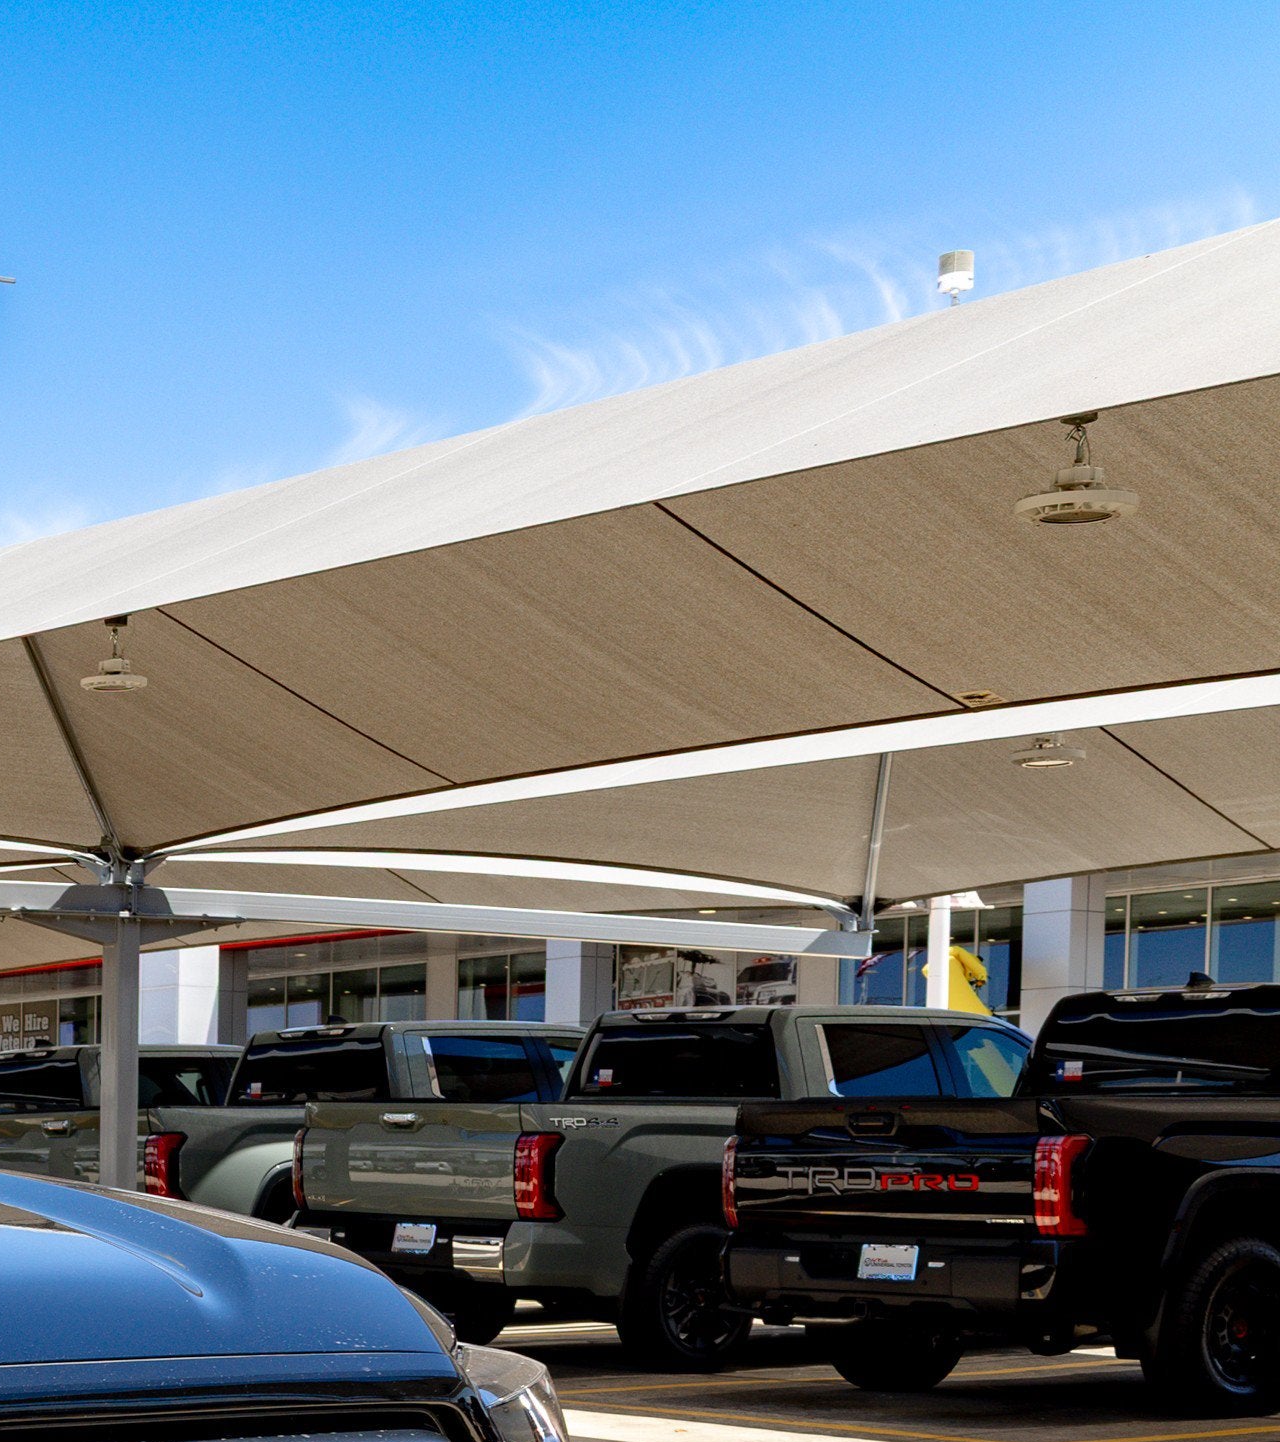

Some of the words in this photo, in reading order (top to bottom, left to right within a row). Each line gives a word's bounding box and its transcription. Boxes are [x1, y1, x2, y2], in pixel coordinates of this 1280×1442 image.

[1, 1015, 20, 1033] We
[24, 1013, 50, 1032] Hire
[549, 1117, 587, 1129] TRD
[777, 1167, 876, 1196] TRD
[880, 1173, 980, 1192] PRO
